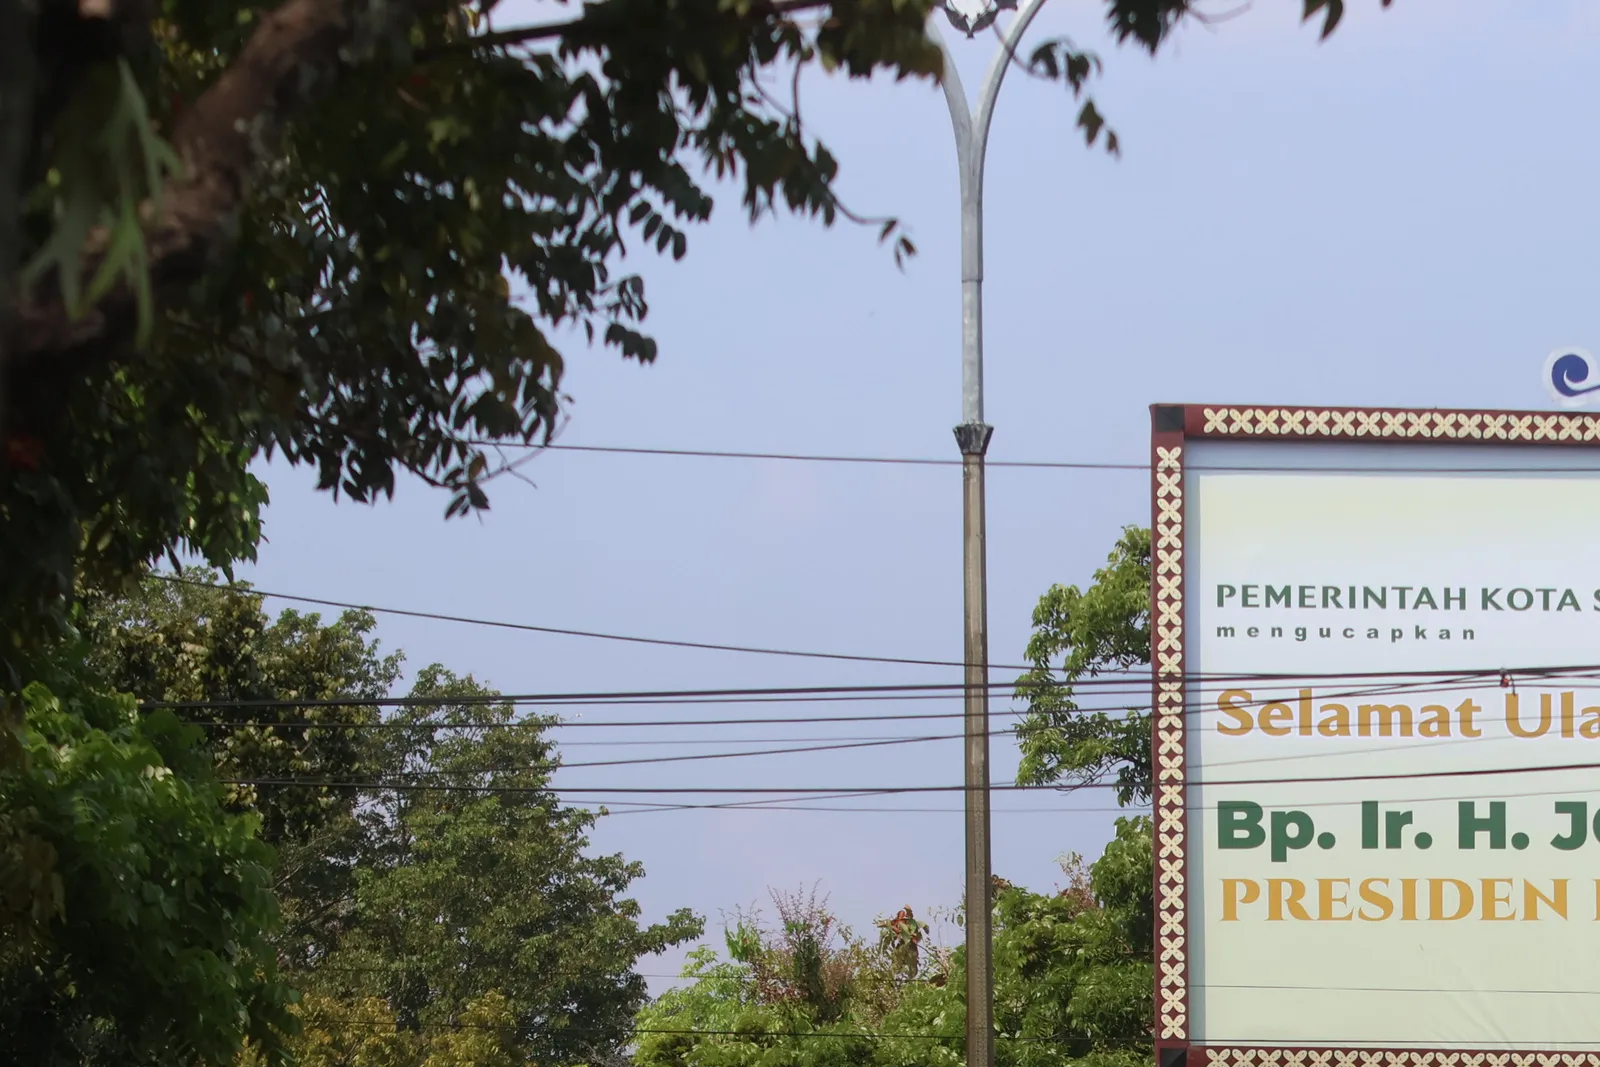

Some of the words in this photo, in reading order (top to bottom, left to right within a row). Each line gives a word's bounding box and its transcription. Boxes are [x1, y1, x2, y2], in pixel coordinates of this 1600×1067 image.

[1216, 584, 1467, 611] PEMERINTAH
[1480, 586, 1582, 612] KOTA
[1216, 625, 1476, 643] mengucapkan
[1215, 687, 1483, 739] Selamat
[1217, 800, 1337, 863] Bp.
[1361, 800, 1434, 850] Ir.
[1458, 800, 1531, 851] H.
[1218, 876, 1572, 922] PRESIDEN
